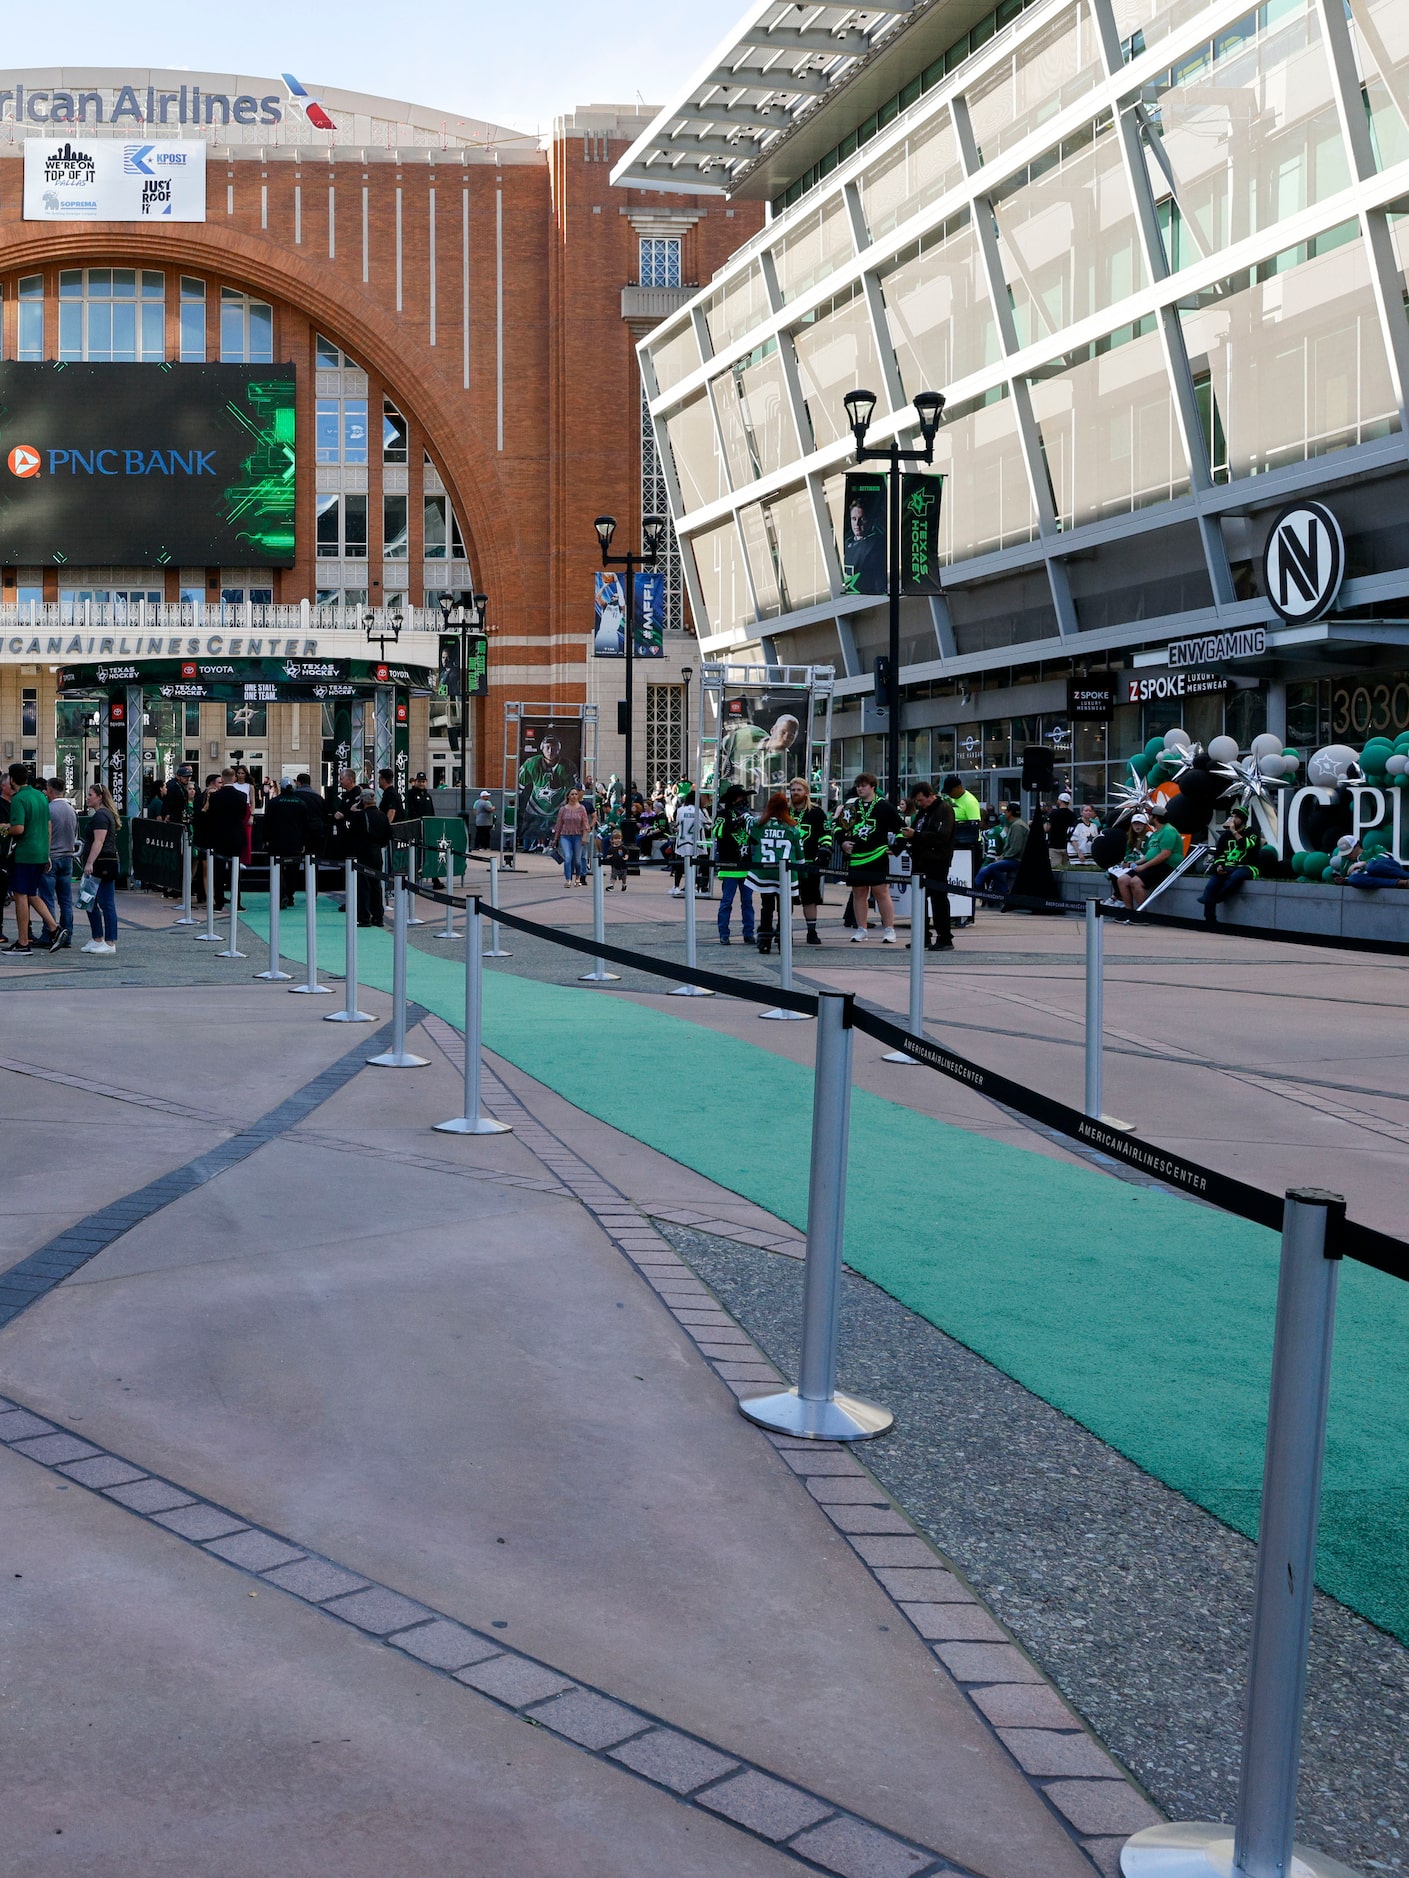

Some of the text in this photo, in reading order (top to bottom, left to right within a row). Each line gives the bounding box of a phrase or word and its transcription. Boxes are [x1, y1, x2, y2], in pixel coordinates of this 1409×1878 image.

[110, 84, 282, 125] Airlines
[45, 162, 95, 170] WE'RE ON
[157, 153, 187, 163] KPOST
[45, 170, 96, 183] TOP OF IT
[142, 178, 172, 193] JUST
[142, 191, 171, 203] ROOF
[46, 449, 217, 475] PNC BANK
[912, 520, 921, 584] HOCKEY
[920, 521, 929, 575] TEXAS
[1278, 518, 1320, 606] N
[642, 578, 655, 640] #MFFL
[1168, 630, 1265, 667] ENVYGAMING
[199, 665, 234, 674] TOYOTA
[389, 671, 410, 679] TOYOTA
[244, 692, 277, 700] ONE TEAM.
[1080, 691, 1109, 700] SPOKE
[1130, 674, 1186, 702] Z SPOKE
[1187, 681, 1228, 693] MENSWEAR
[1333, 682, 1409, 734] 3030
[764, 829, 786, 839] STACY
[1209, 786, 1332, 863] NC
[145, 837, 175, 849] DALLAS
[760, 838, 792, 864] 57
[904, 1038, 984, 1085] AMERICANAIRLINESCENTER
[1078, 1121, 1207, 1191] AMERICANAIRLINESCENTER
